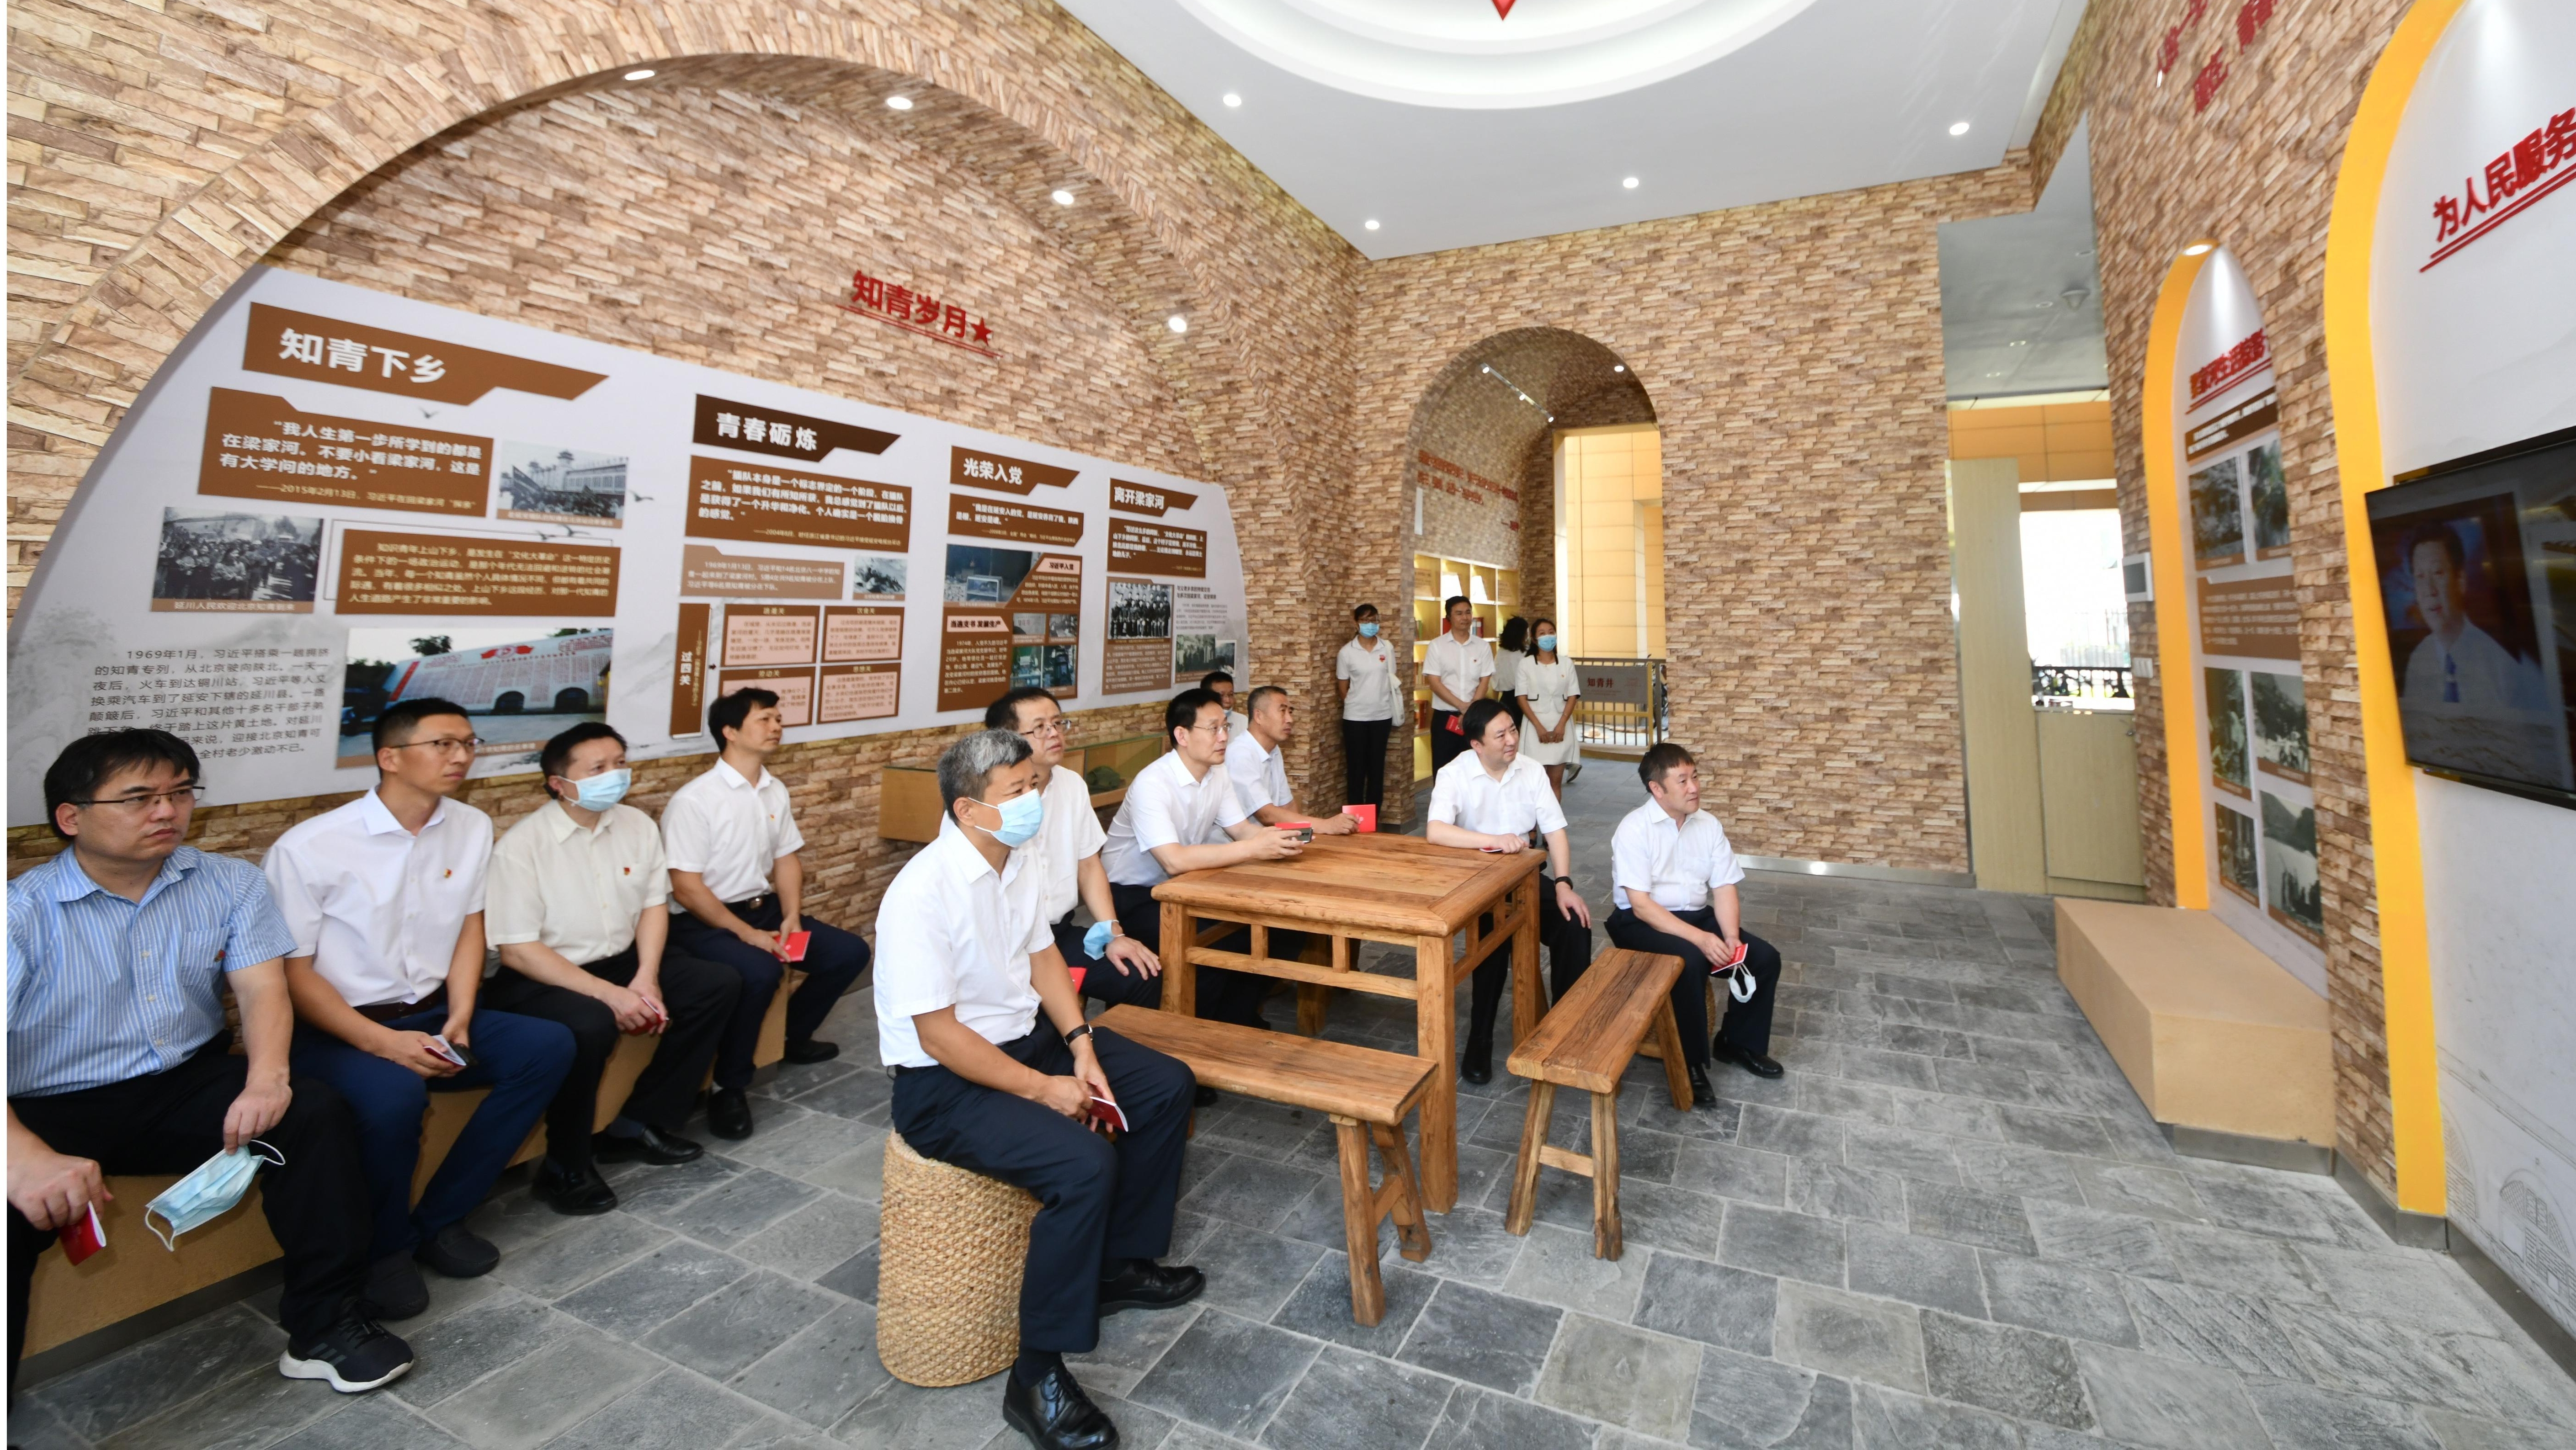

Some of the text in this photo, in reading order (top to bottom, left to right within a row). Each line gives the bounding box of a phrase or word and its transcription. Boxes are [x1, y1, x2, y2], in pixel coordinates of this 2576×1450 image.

[2432, 106, 2576, 243] 为人民服务
[852, 270, 966, 338] 知青岁月
[278, 329, 446, 384] 知青下乡
[716, 412, 818, 451] 青春砺炼
[963, 457, 1022, 485] 光荣入党
[1114, 487, 1165, 510] 离开梁家河
[679, 651, 693, 686] 过四关
[1587, 677, 1614, 688] 知青井
